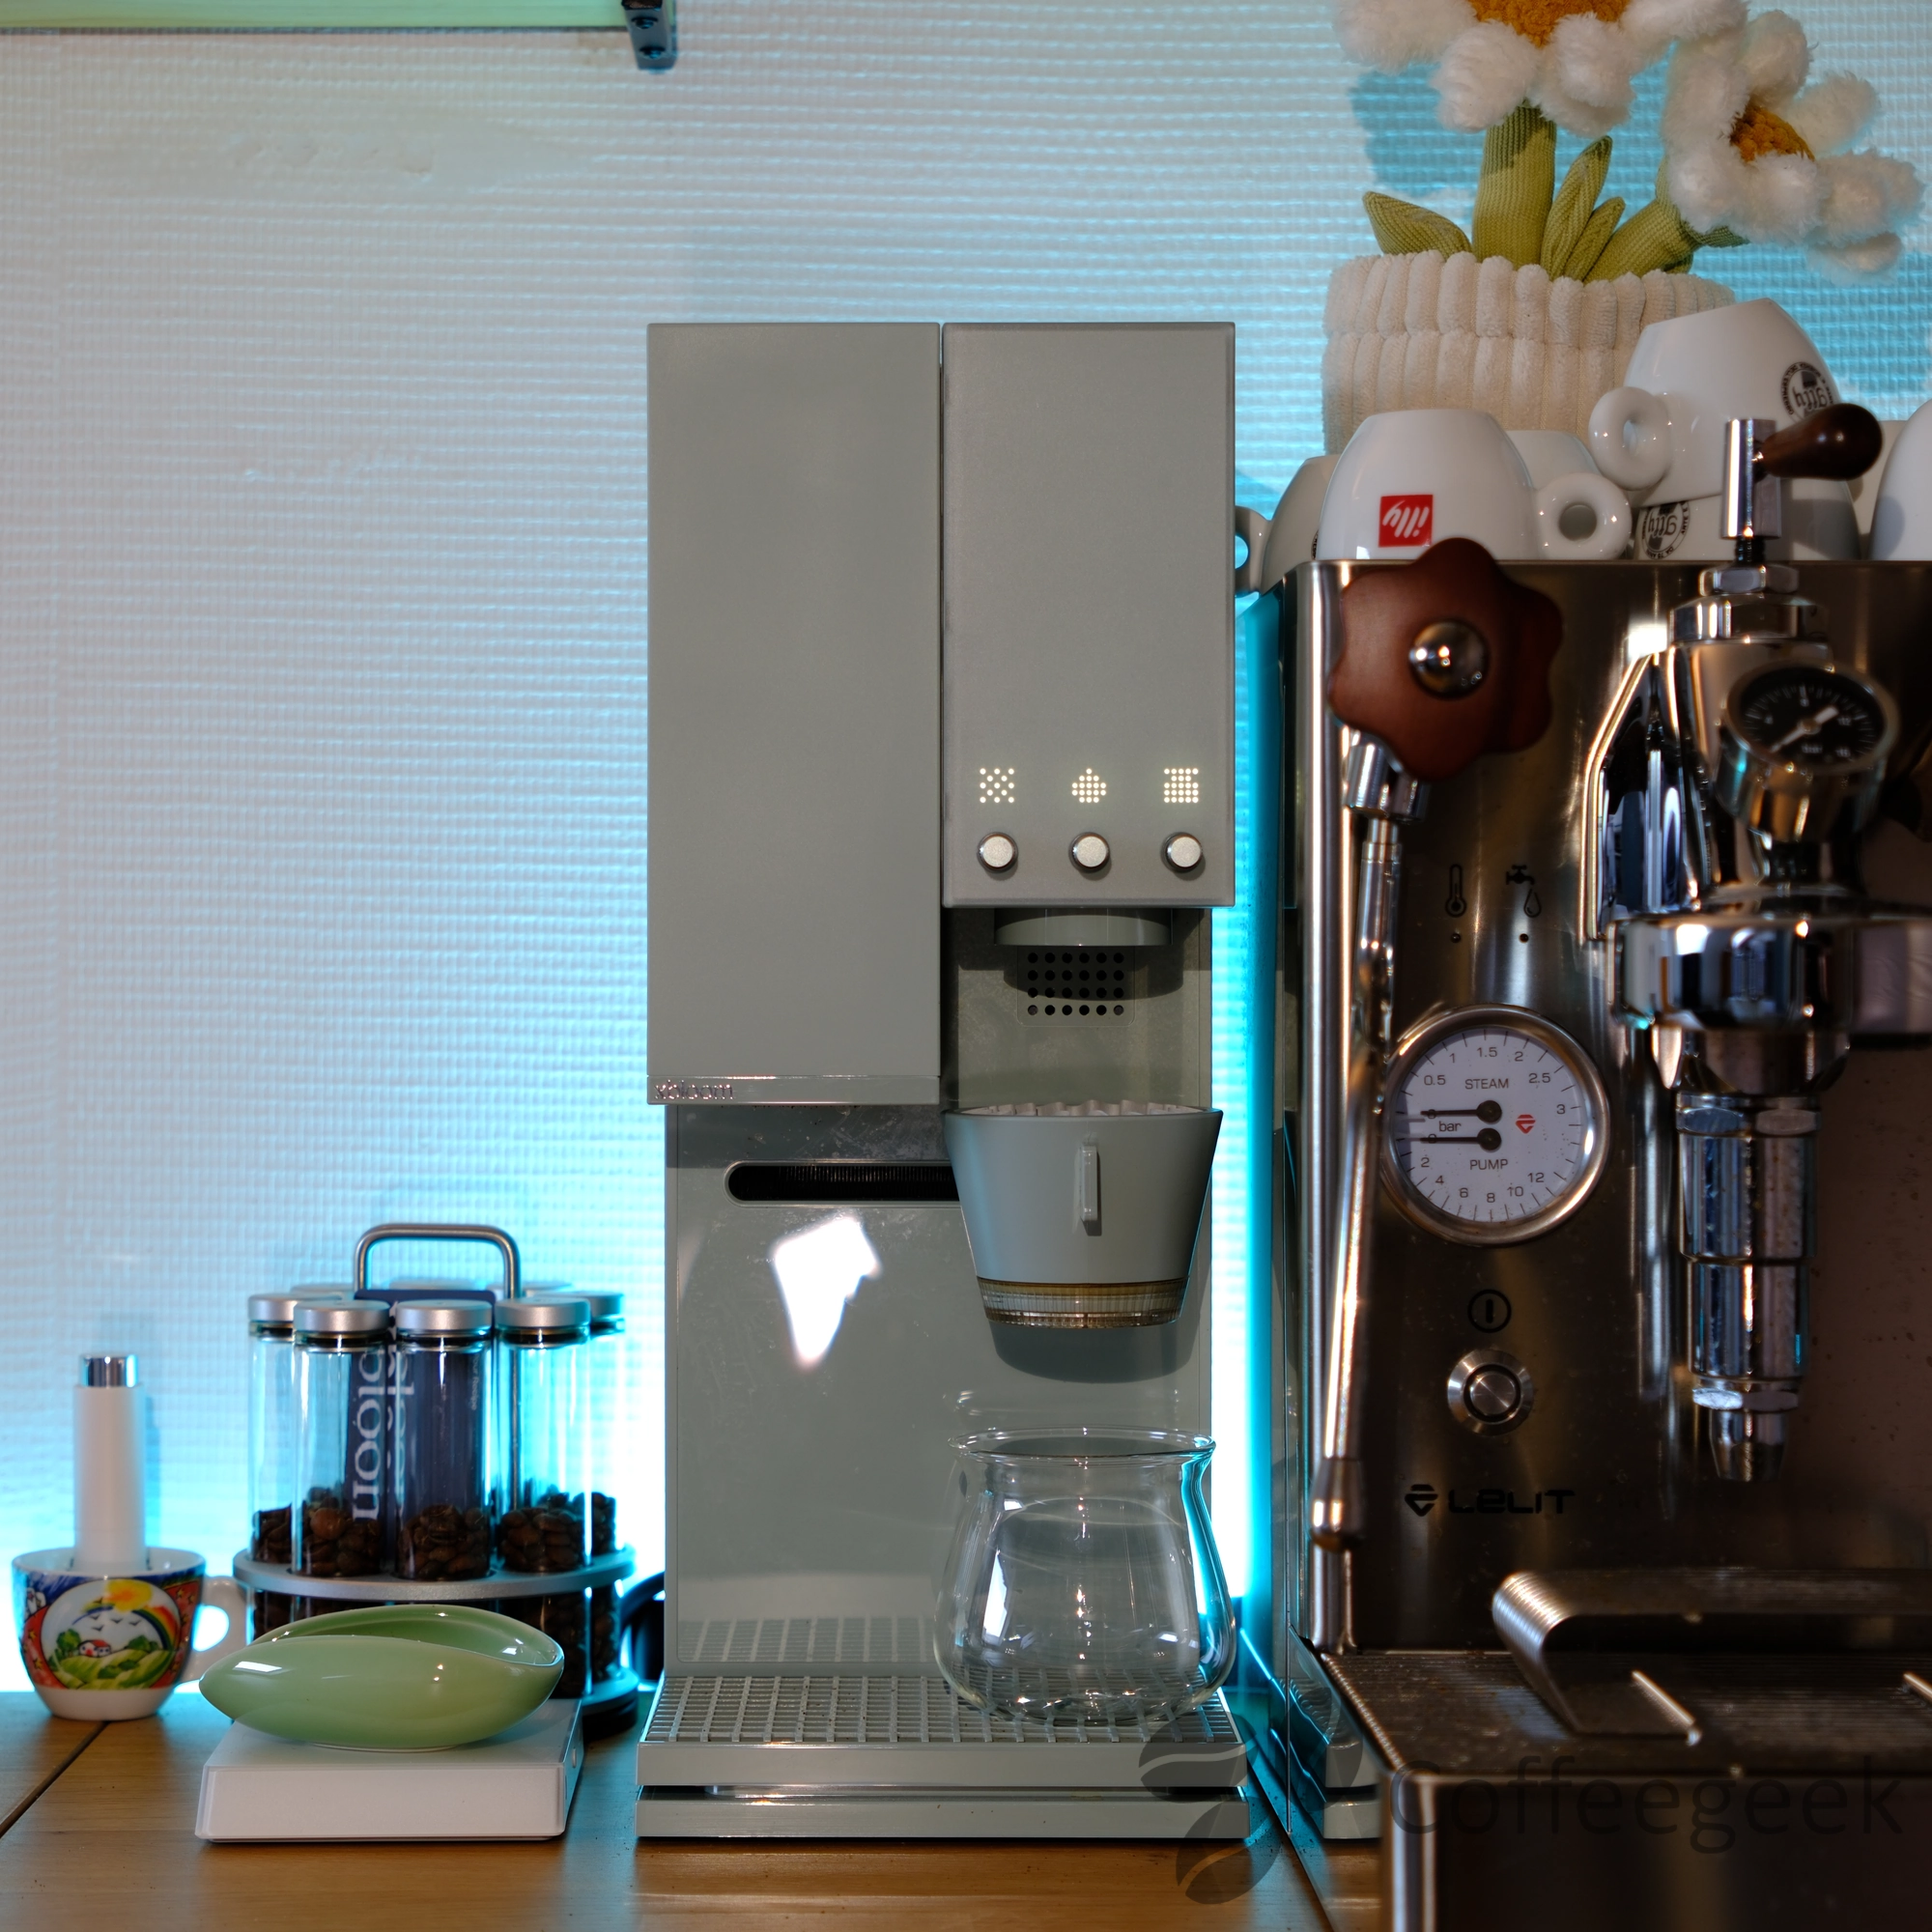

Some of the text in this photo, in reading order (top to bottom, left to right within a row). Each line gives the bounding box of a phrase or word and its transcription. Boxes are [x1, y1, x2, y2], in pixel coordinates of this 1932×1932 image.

[1381, 499, 1430, 538] illy
[1449, 1053, 1456, 1063] 1
[1477, 1047, 1497, 1058] 1.5
[1514, 1051, 1523, 1062] 2
[1424, 1075, 1446, 1086] 0.5
[1528, 1072, 1550, 1084] 2.5
[1464, 1078, 1509, 1090] STEAM
[1556, 1104, 1566, 1115] 3
[1438, 1121, 1462, 1131] bar
[1421, 1157, 1430, 1168] 2
[1469, 1159, 1508, 1170] PUMP
[1435, 1176, 1444, 1184] 4
[1527, 1173, 1545, 1183] 12
[1460, 1187, 1468, 1198] 6
[1507, 1186, 1524, 1197] 10
[1487, 1193, 1495, 1203] 8
